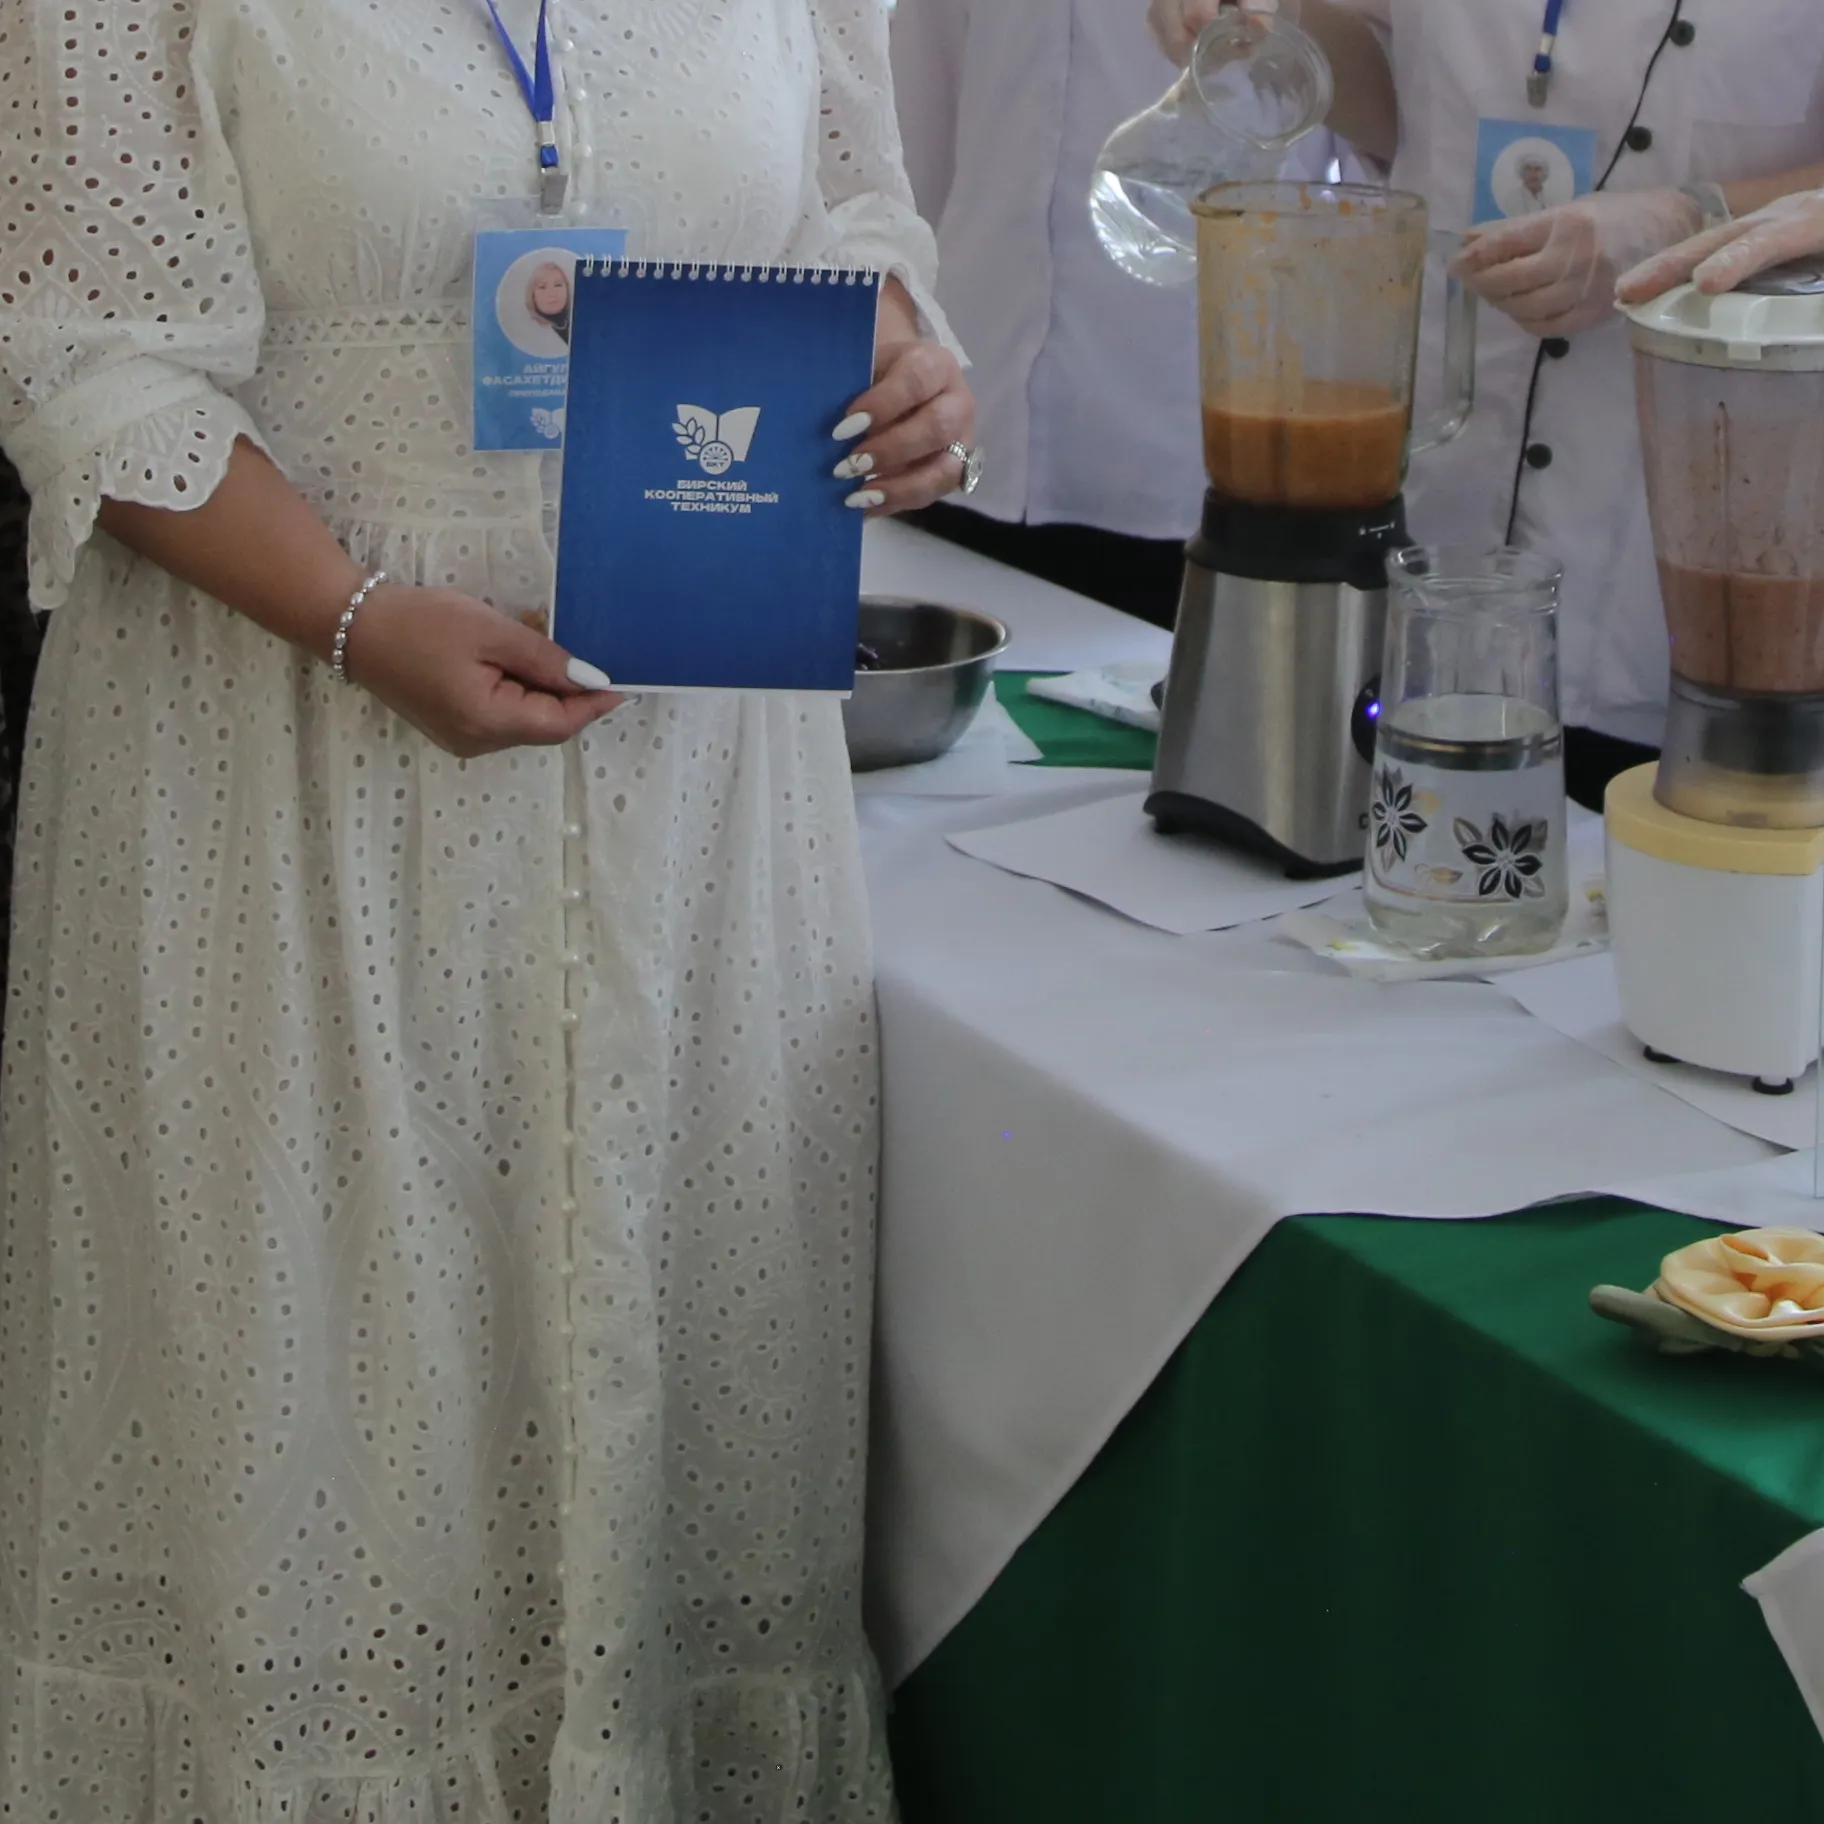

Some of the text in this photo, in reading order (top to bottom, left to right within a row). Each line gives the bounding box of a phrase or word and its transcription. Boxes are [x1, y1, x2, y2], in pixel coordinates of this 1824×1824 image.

[524, 363, 568, 374] АЙГУЛ
[482, 374, 568, 386] ФАСАХЕТДИ
[677, 480, 748, 491] БИРСКИЙ
[644, 489, 779, 504] КООПЕРАТИВНЫЙ
[671, 502, 752, 514] ТЕХНИКУМ
